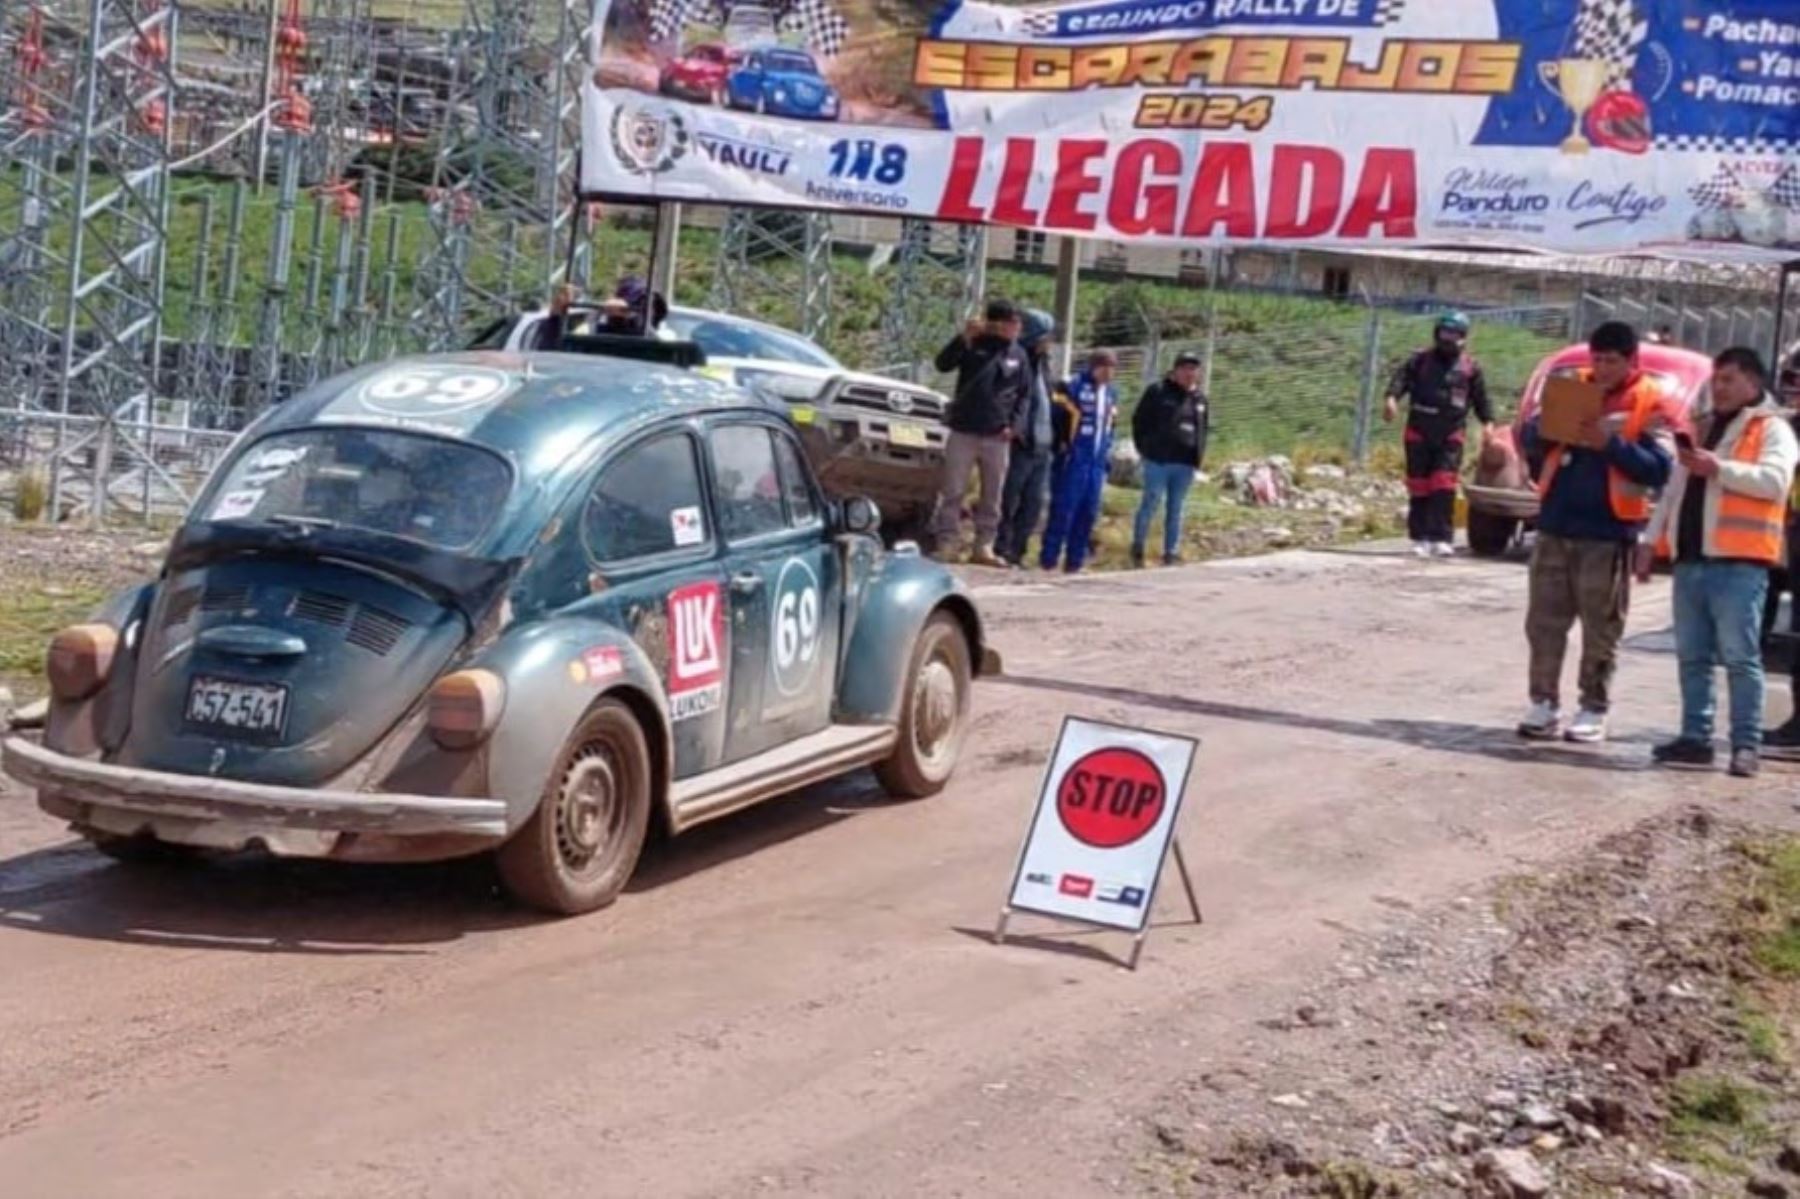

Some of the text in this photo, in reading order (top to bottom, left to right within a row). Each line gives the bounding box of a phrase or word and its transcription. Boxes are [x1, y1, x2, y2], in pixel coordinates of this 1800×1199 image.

[1212, 0, 1306, 18] RALLY
[1315, 0, 1359, 17] DE
[1703, 14, 1800, 45] Pacha
[914, 35, 1522, 94] ESCARABAJOS
[1134, 94, 1274, 129] 2024
[805, 180, 908, 208] Aniversario
[937, 135, 1417, 238] LLEGADA
[1442, 191, 1549, 213] Panduro
[1566, 180, 1667, 228] Contigo
[367, 371, 502, 405] 69
[776, 587, 818, 668] 69
[1066, 770, 1159, 820] STOP
